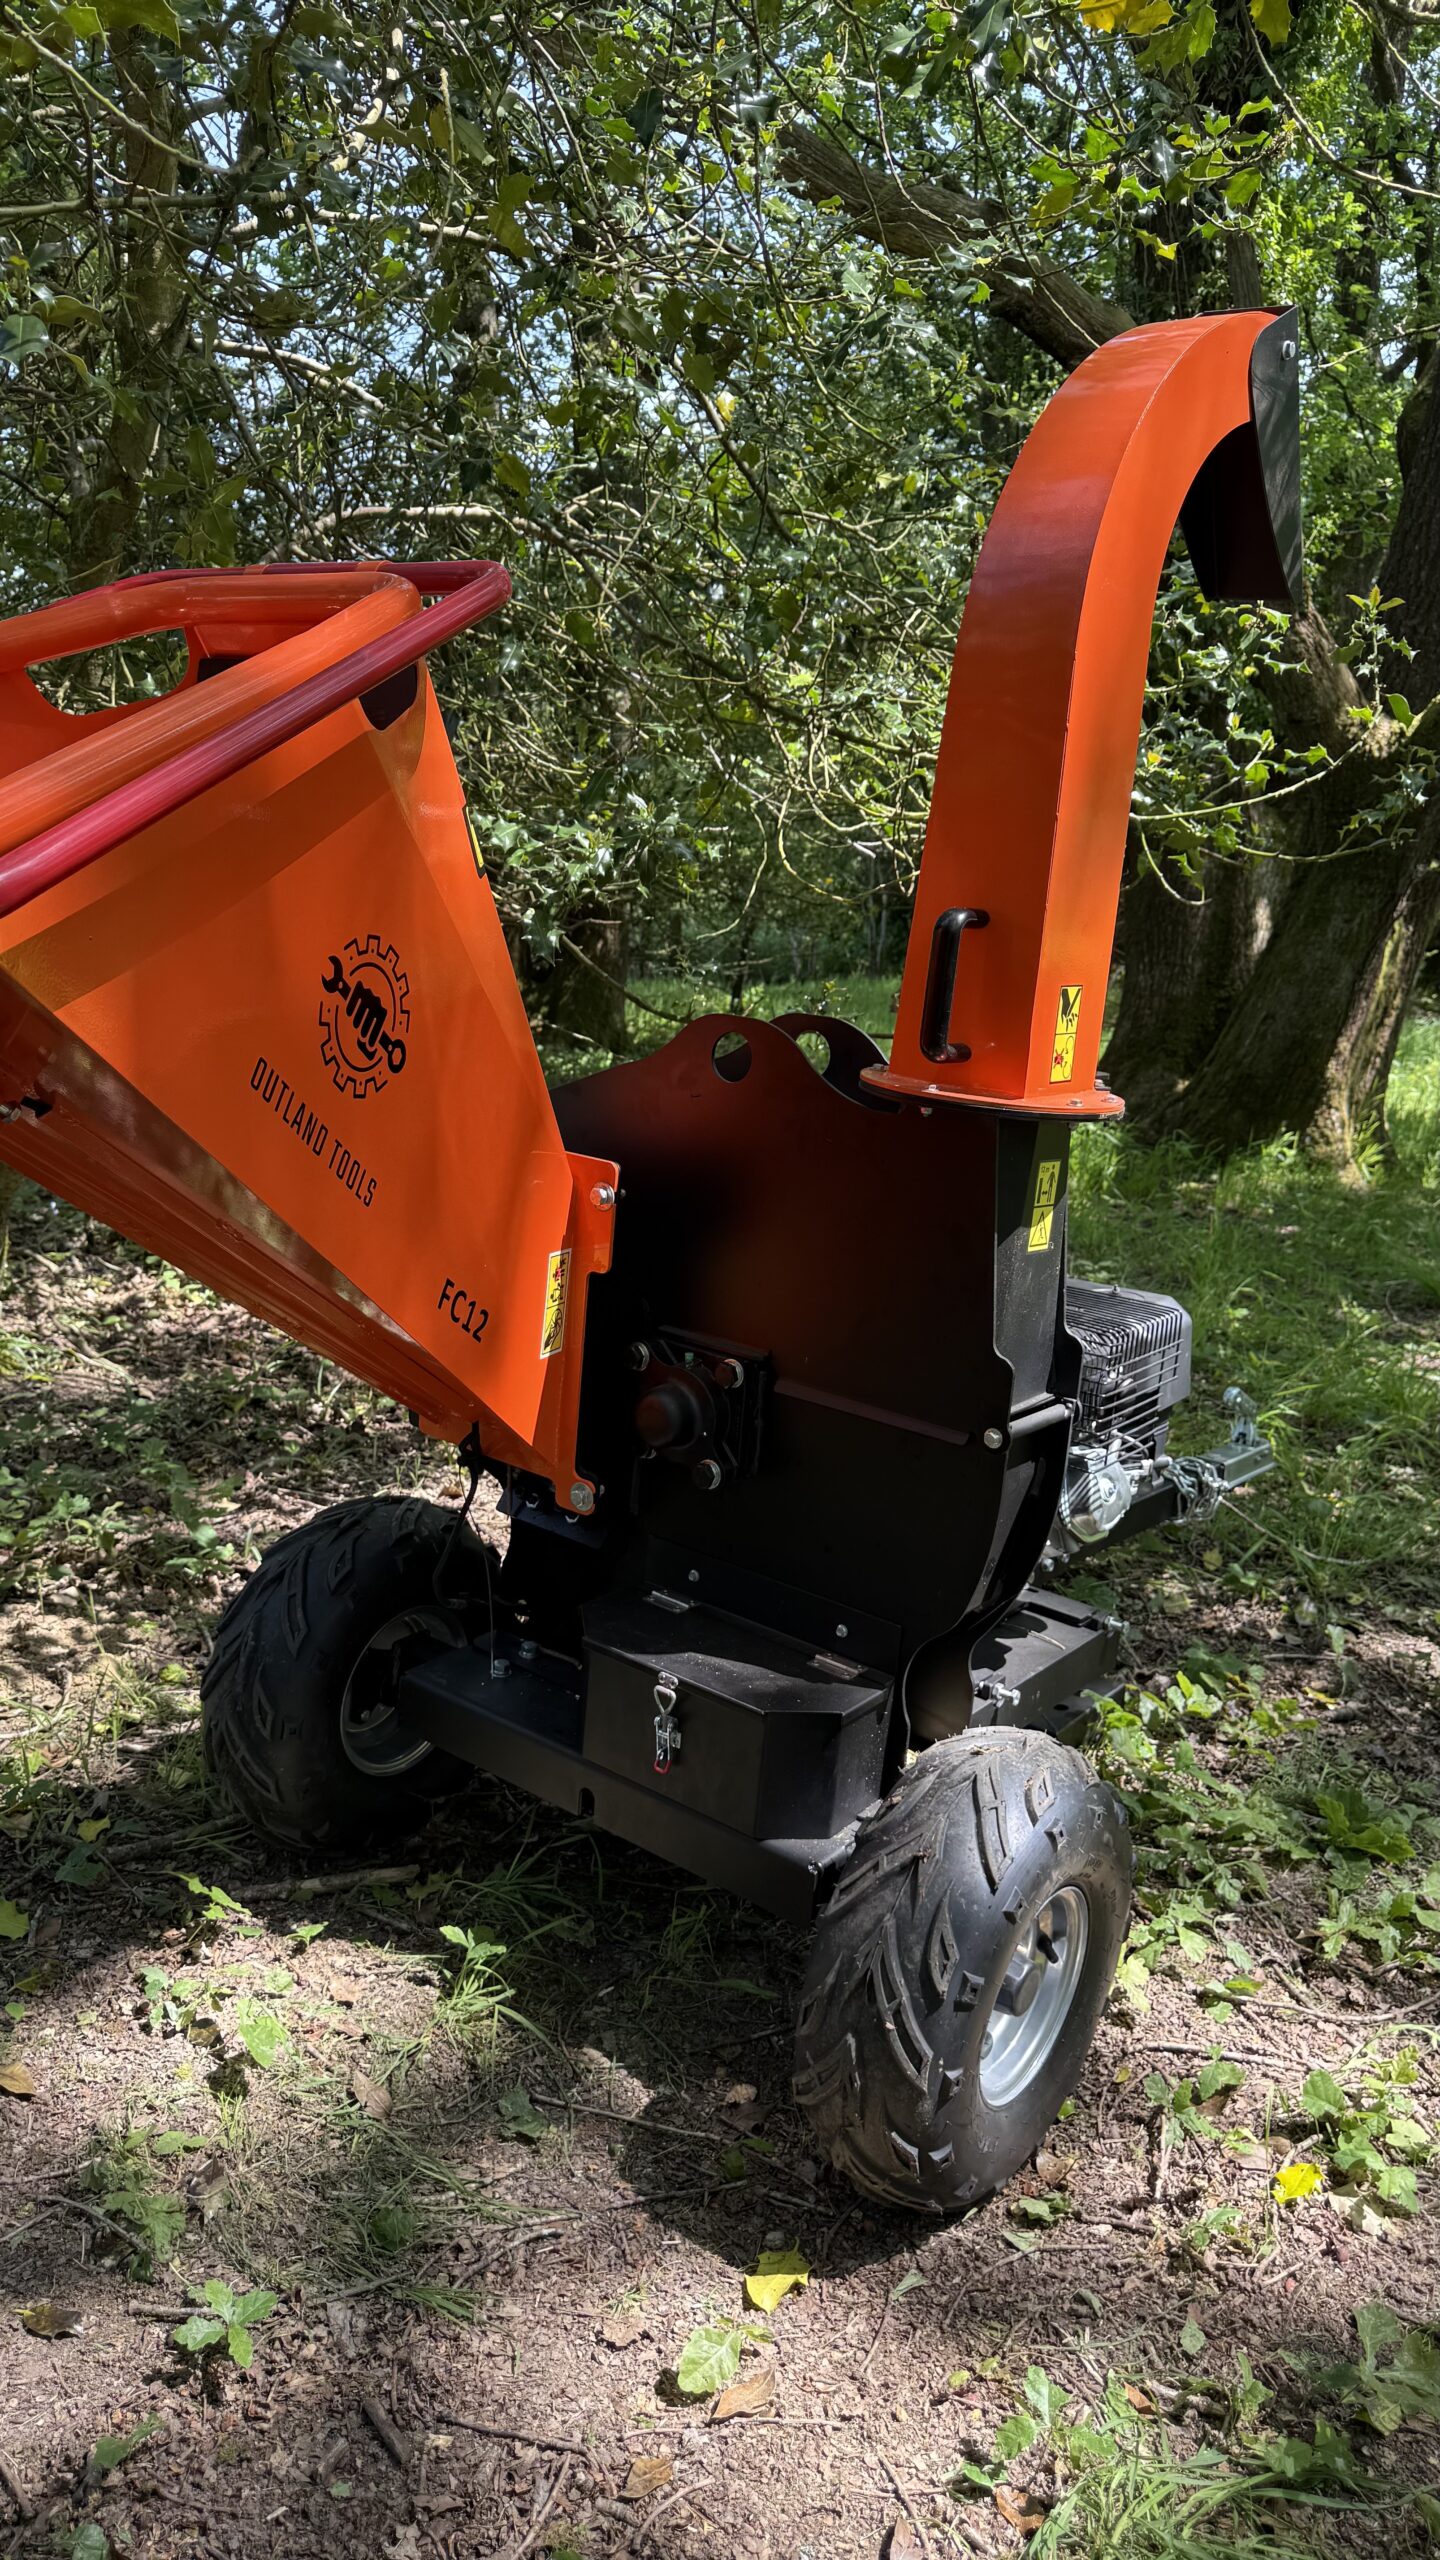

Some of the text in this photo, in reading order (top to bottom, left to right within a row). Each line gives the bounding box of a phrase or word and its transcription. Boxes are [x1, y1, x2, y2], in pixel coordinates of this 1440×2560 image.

[250, 1057, 377, 1207] OUTLAND TOOLS
[438, 1278, 489, 1343] FC12
